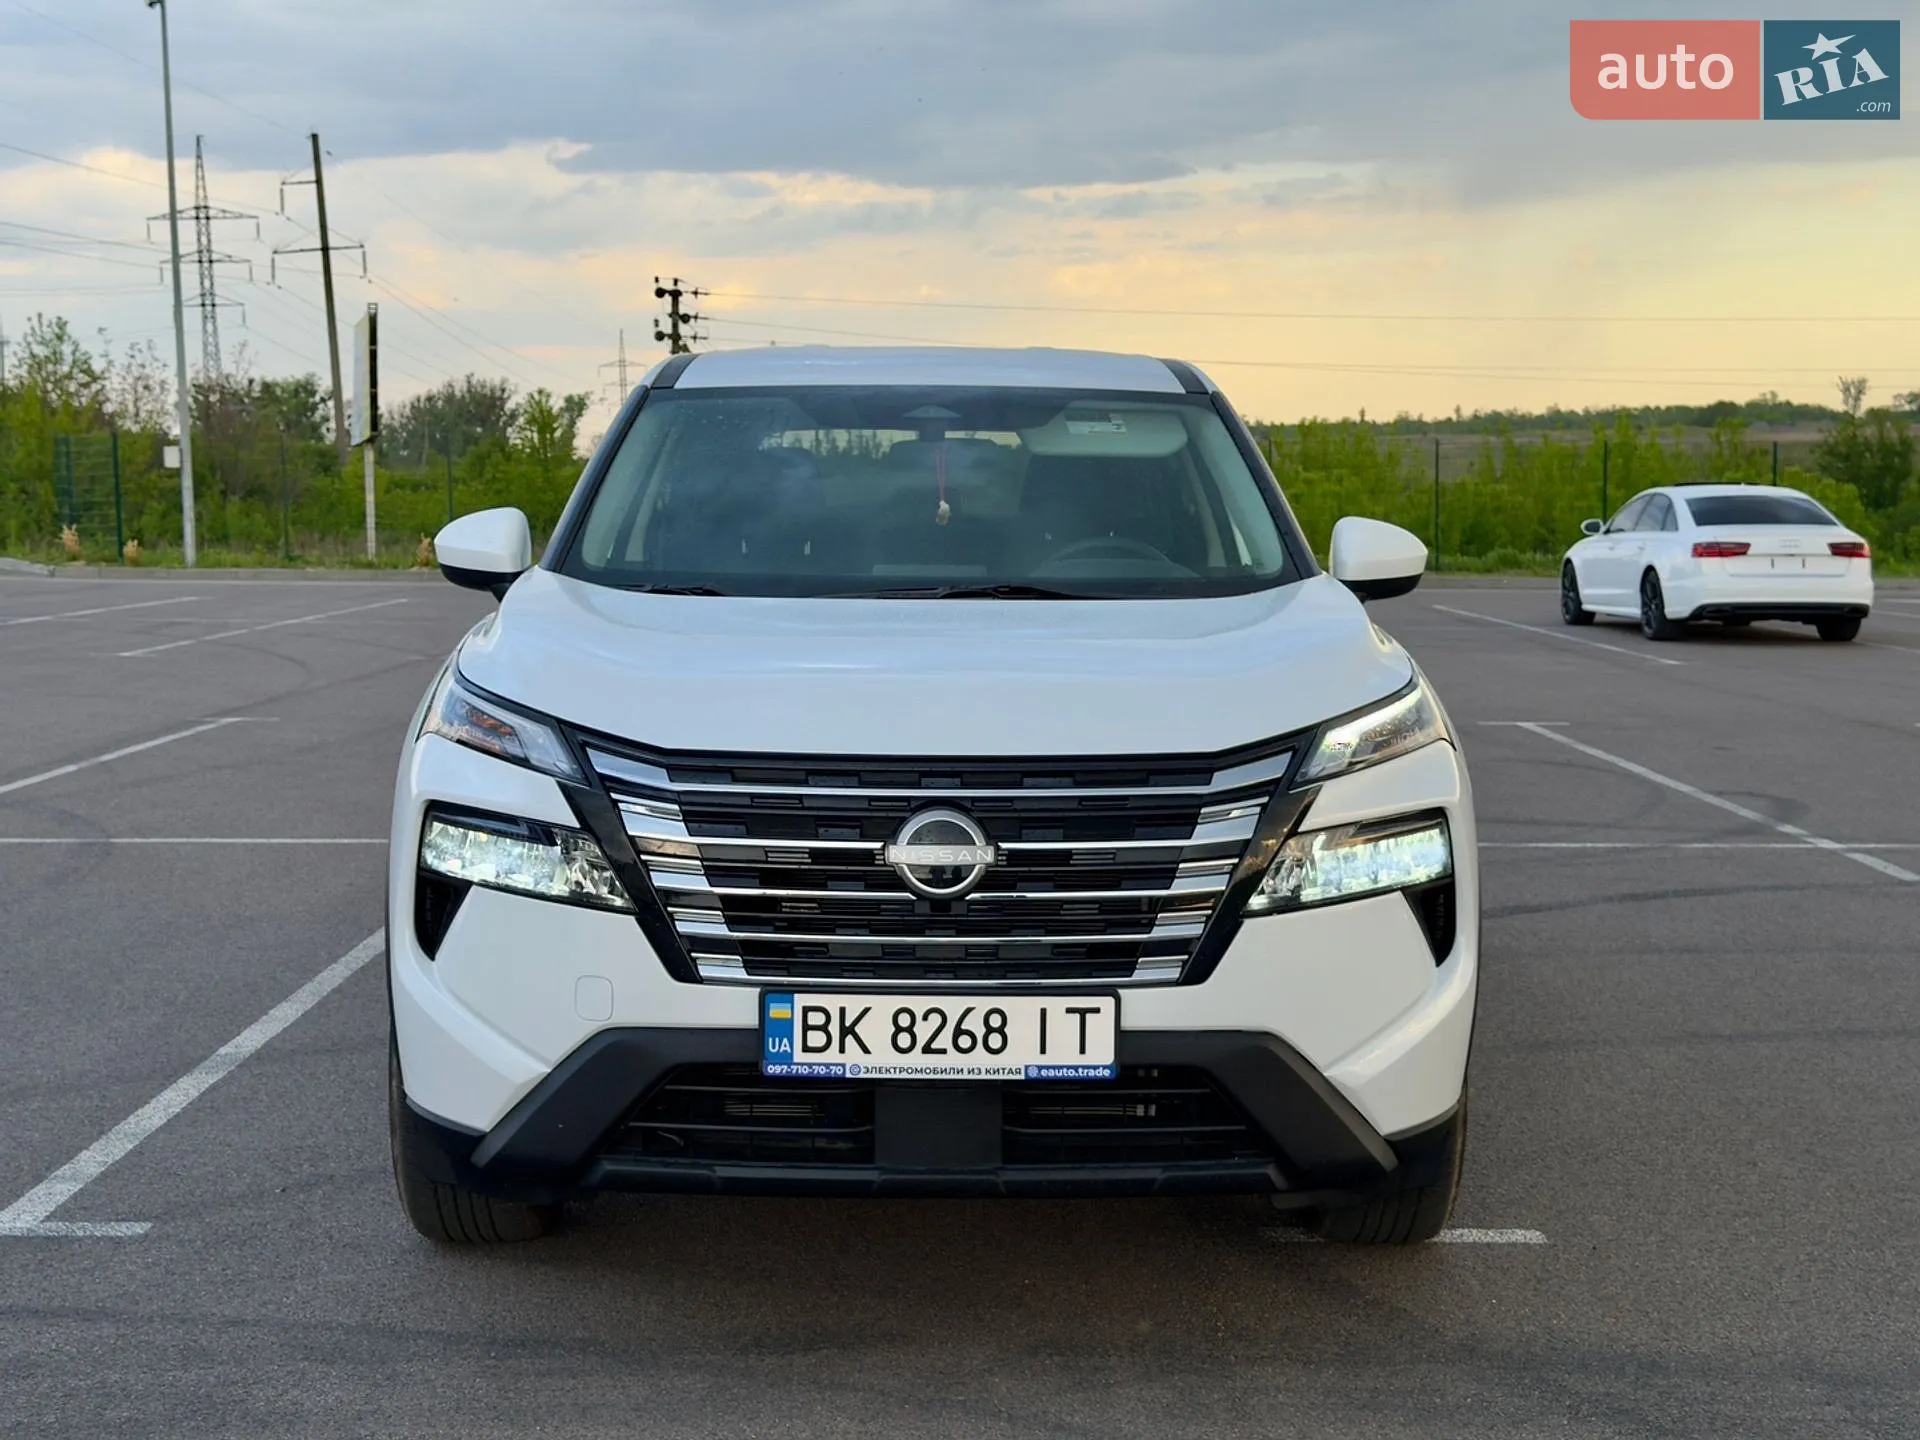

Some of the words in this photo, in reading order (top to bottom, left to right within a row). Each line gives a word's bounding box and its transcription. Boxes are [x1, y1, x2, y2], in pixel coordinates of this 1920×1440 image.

[891, 849, 992, 862] NISSAN
[800, 1005, 873, 1055] BK
[890, 1006, 1009, 1056] 8268
[1038, 1006, 1102, 1056] IT
[768, 1037, 792, 1053] UA
[767, 1064, 844, 1075] 097-710-70-70
[863, 1065, 964, 1076] ЭЛЕКТРОМОБИЛИ
[967, 1066, 982, 1076] ИЗ
[985, 1066, 1022, 1077] КИТАЯ
